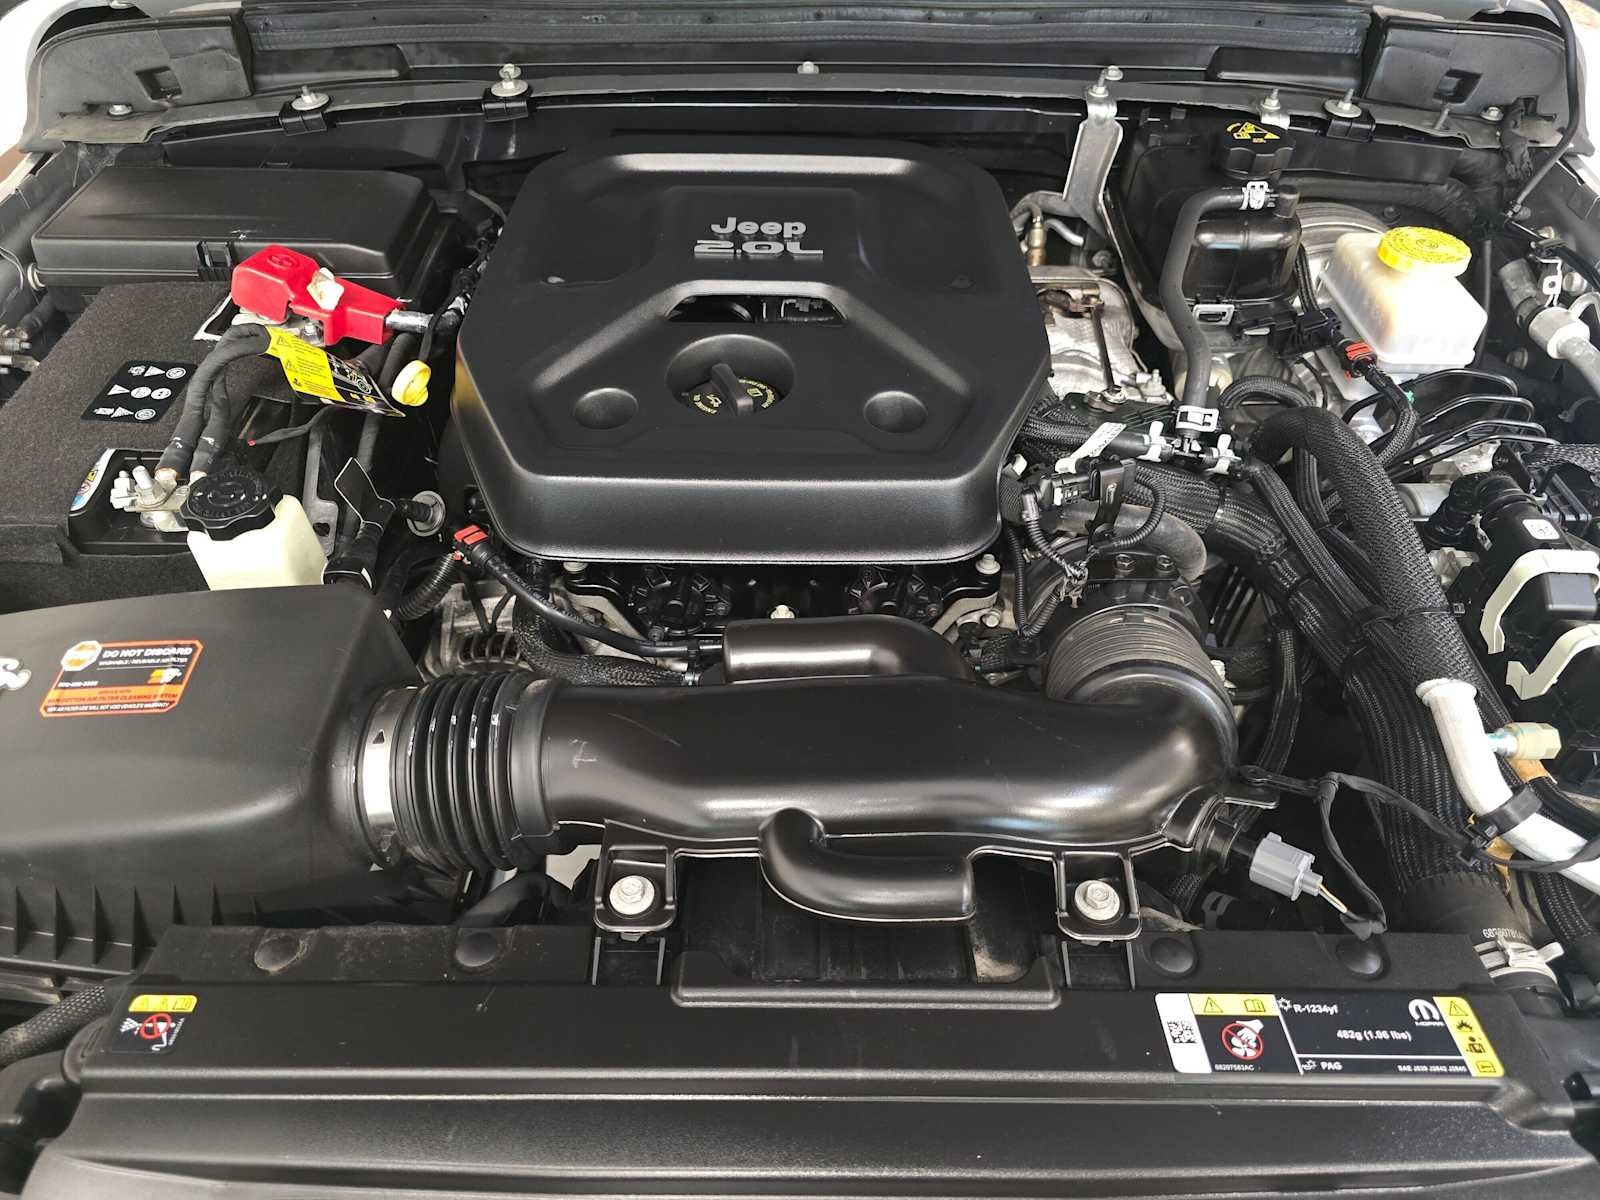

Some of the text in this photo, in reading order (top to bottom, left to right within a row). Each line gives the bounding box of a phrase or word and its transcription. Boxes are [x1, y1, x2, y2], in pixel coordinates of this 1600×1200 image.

[711, 217, 806, 238] Jeep
[694, 240, 824, 254] 2.0L
[103, 648, 193, 659] DO NOT DISCARD
[1293, 1003, 1338, 1015] R-1234yf
[1364, 1030, 1389, 1040] (1.06
[1390, 1030, 1411, 1042] lbs)
[1320, 1061, 1342, 1071] PAG
